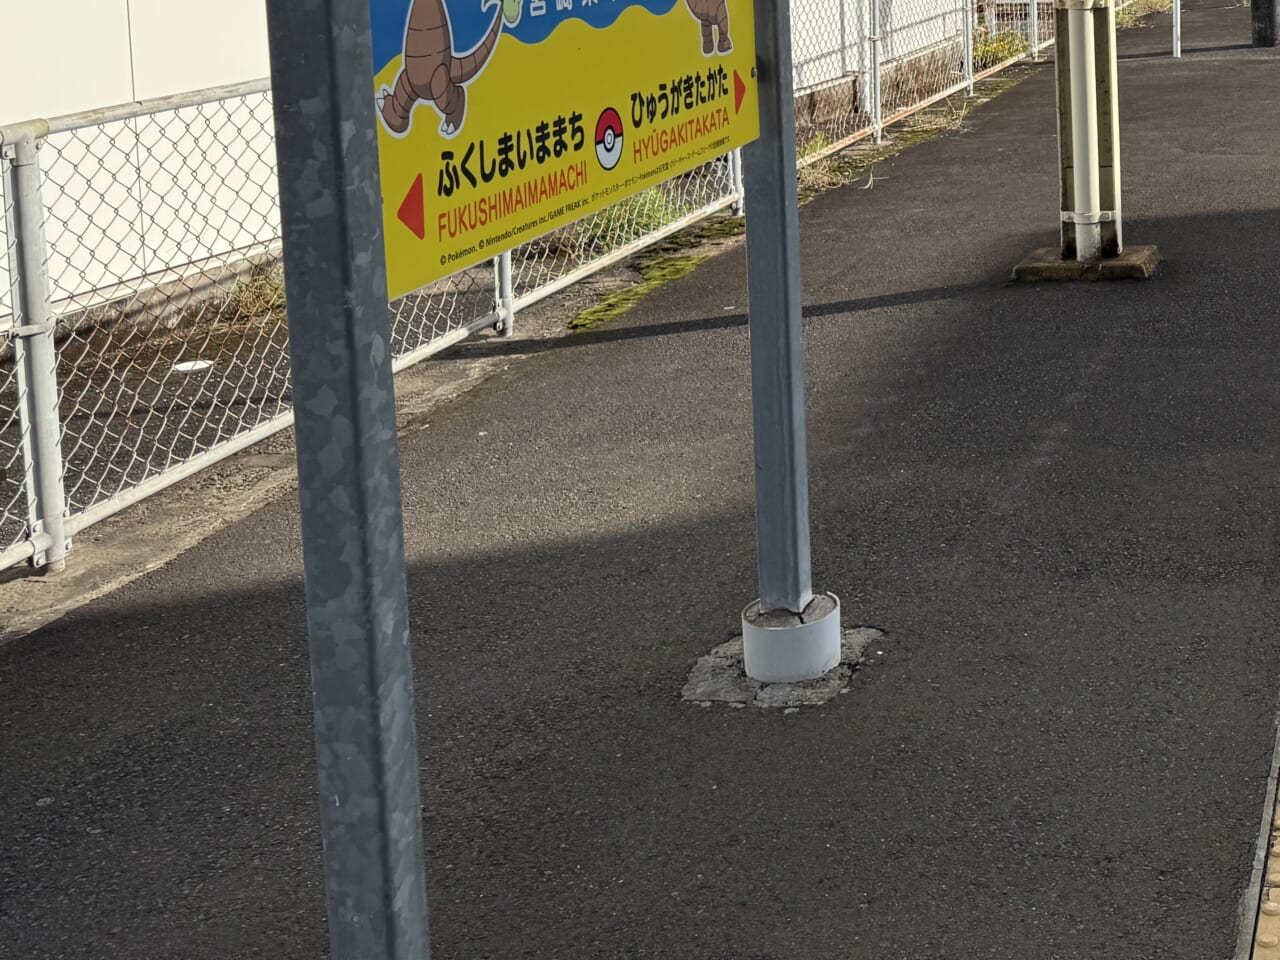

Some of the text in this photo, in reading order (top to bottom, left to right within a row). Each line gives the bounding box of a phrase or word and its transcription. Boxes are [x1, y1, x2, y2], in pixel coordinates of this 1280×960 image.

[631, 64, 729, 128] ひゅうがきたかた
[437, 111, 585, 197] ふくしまいままち
[437, 160, 588, 242] FUKUSHIMAIMAMACHI
